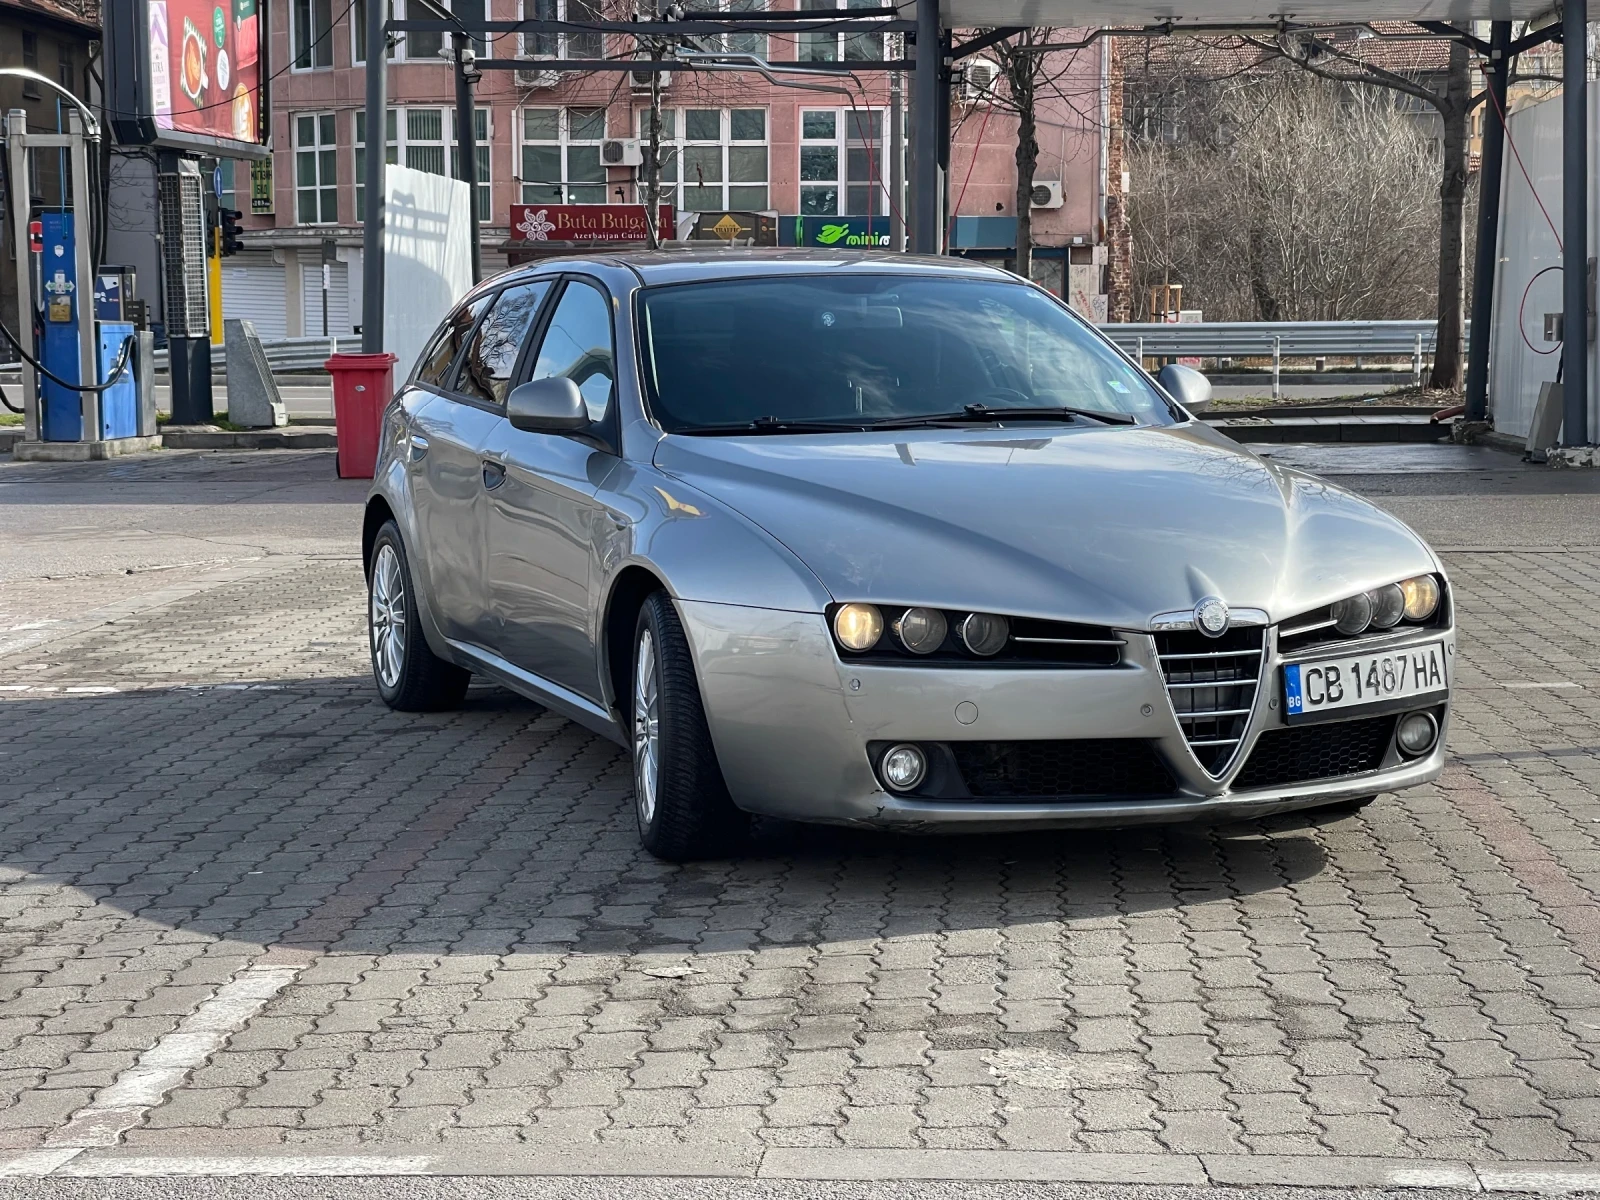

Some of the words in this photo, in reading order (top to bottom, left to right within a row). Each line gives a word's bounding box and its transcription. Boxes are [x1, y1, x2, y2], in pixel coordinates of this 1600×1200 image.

[557, 213, 597, 229] Buta
[601, 212, 668, 232] Bulgaa
[573, 232, 619, 241] Azerbaijan
[1305, 665, 1344, 705] CB
[1351, 655, 1408, 698] 1487
[1411, 650, 1442, 689] HA
[1289, 695, 1301, 708] BG
